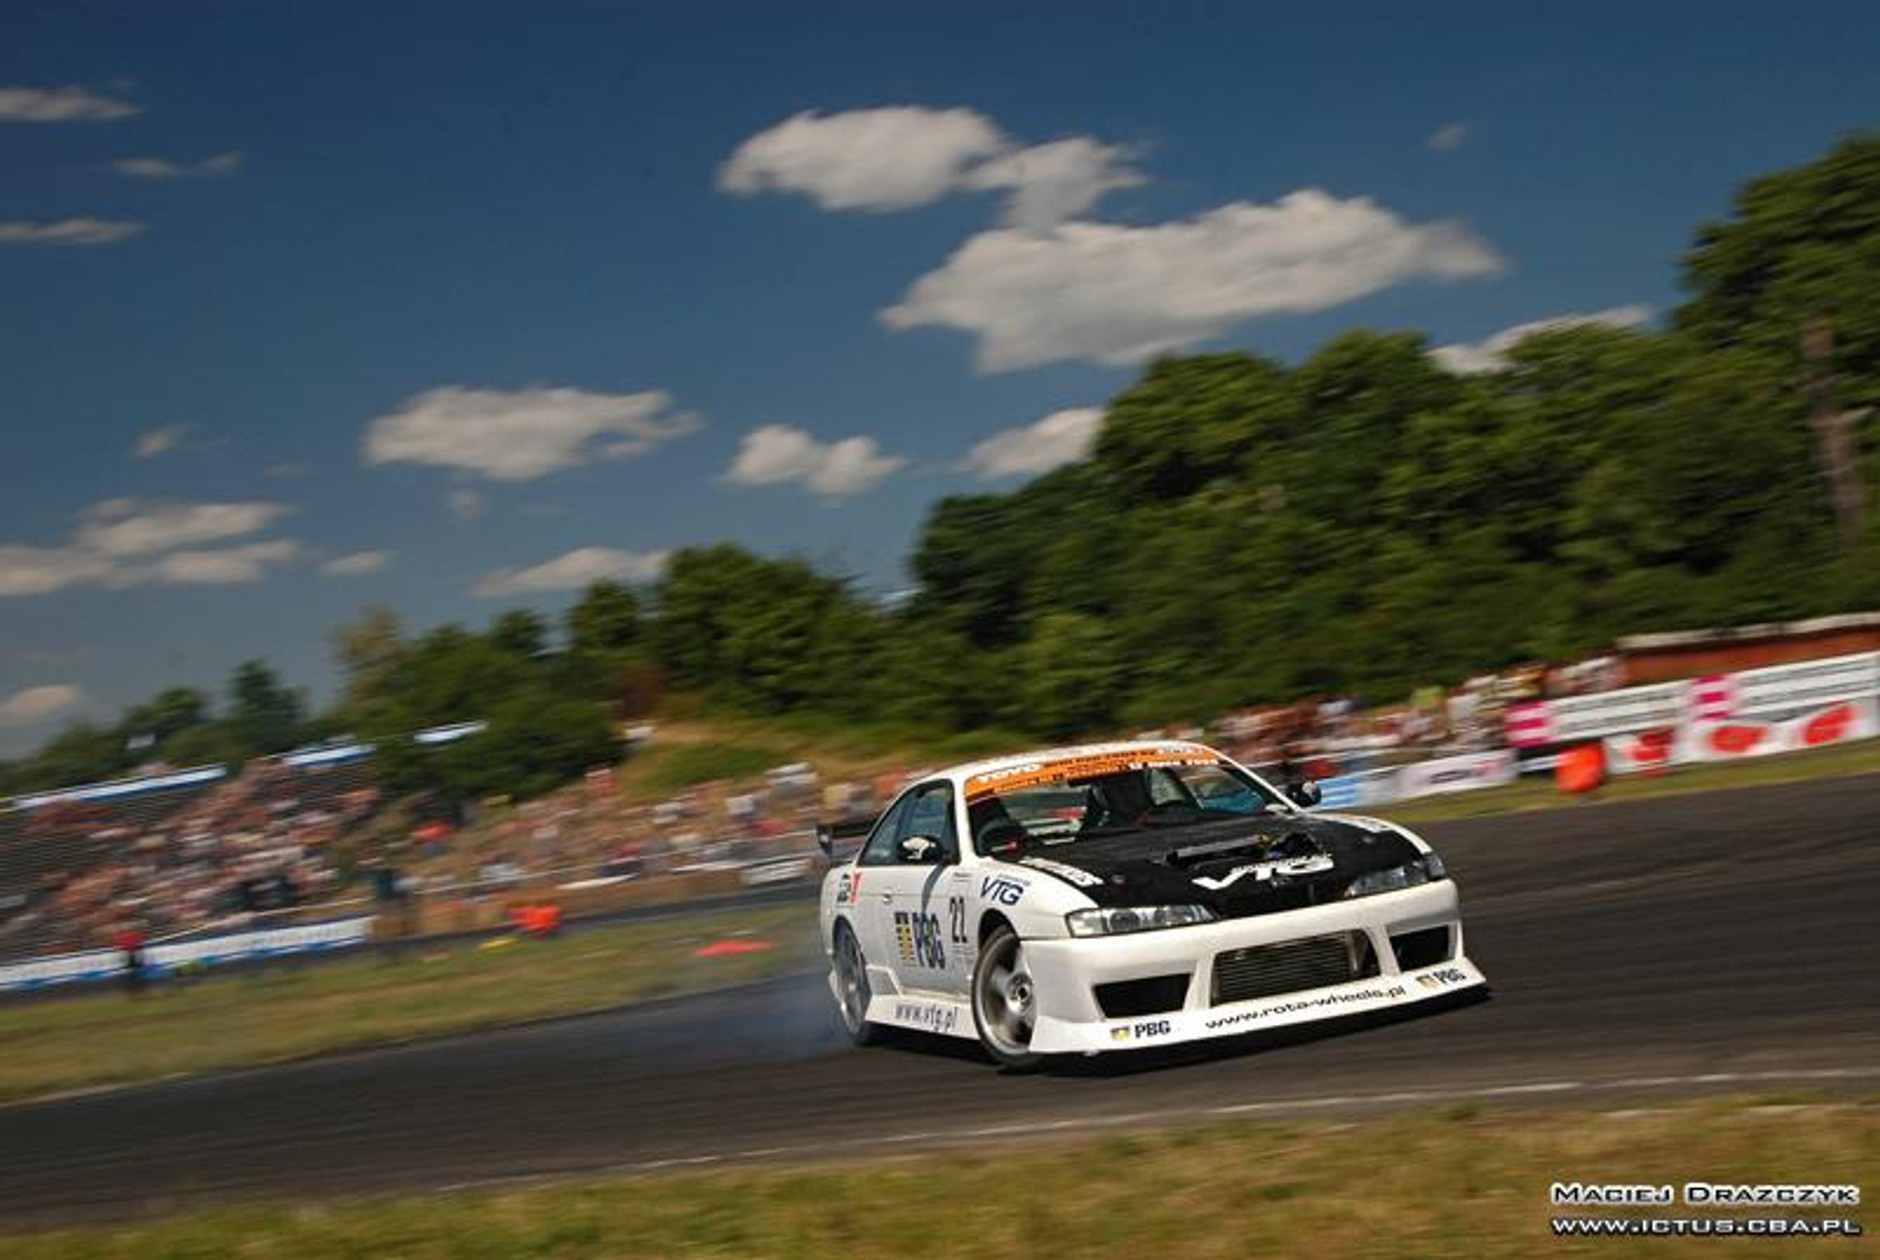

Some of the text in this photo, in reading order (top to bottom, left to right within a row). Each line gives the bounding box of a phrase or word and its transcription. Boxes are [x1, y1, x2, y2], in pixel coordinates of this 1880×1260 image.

[980, 875, 1024, 906] VTG
[911, 911, 946, 969] PBG
[895, 1003, 959, 1033] www.vtg.pl
[1204, 984, 1406, 1030] www.rota-wheels.pl
[1134, 1020, 1171, 1039] PBG
